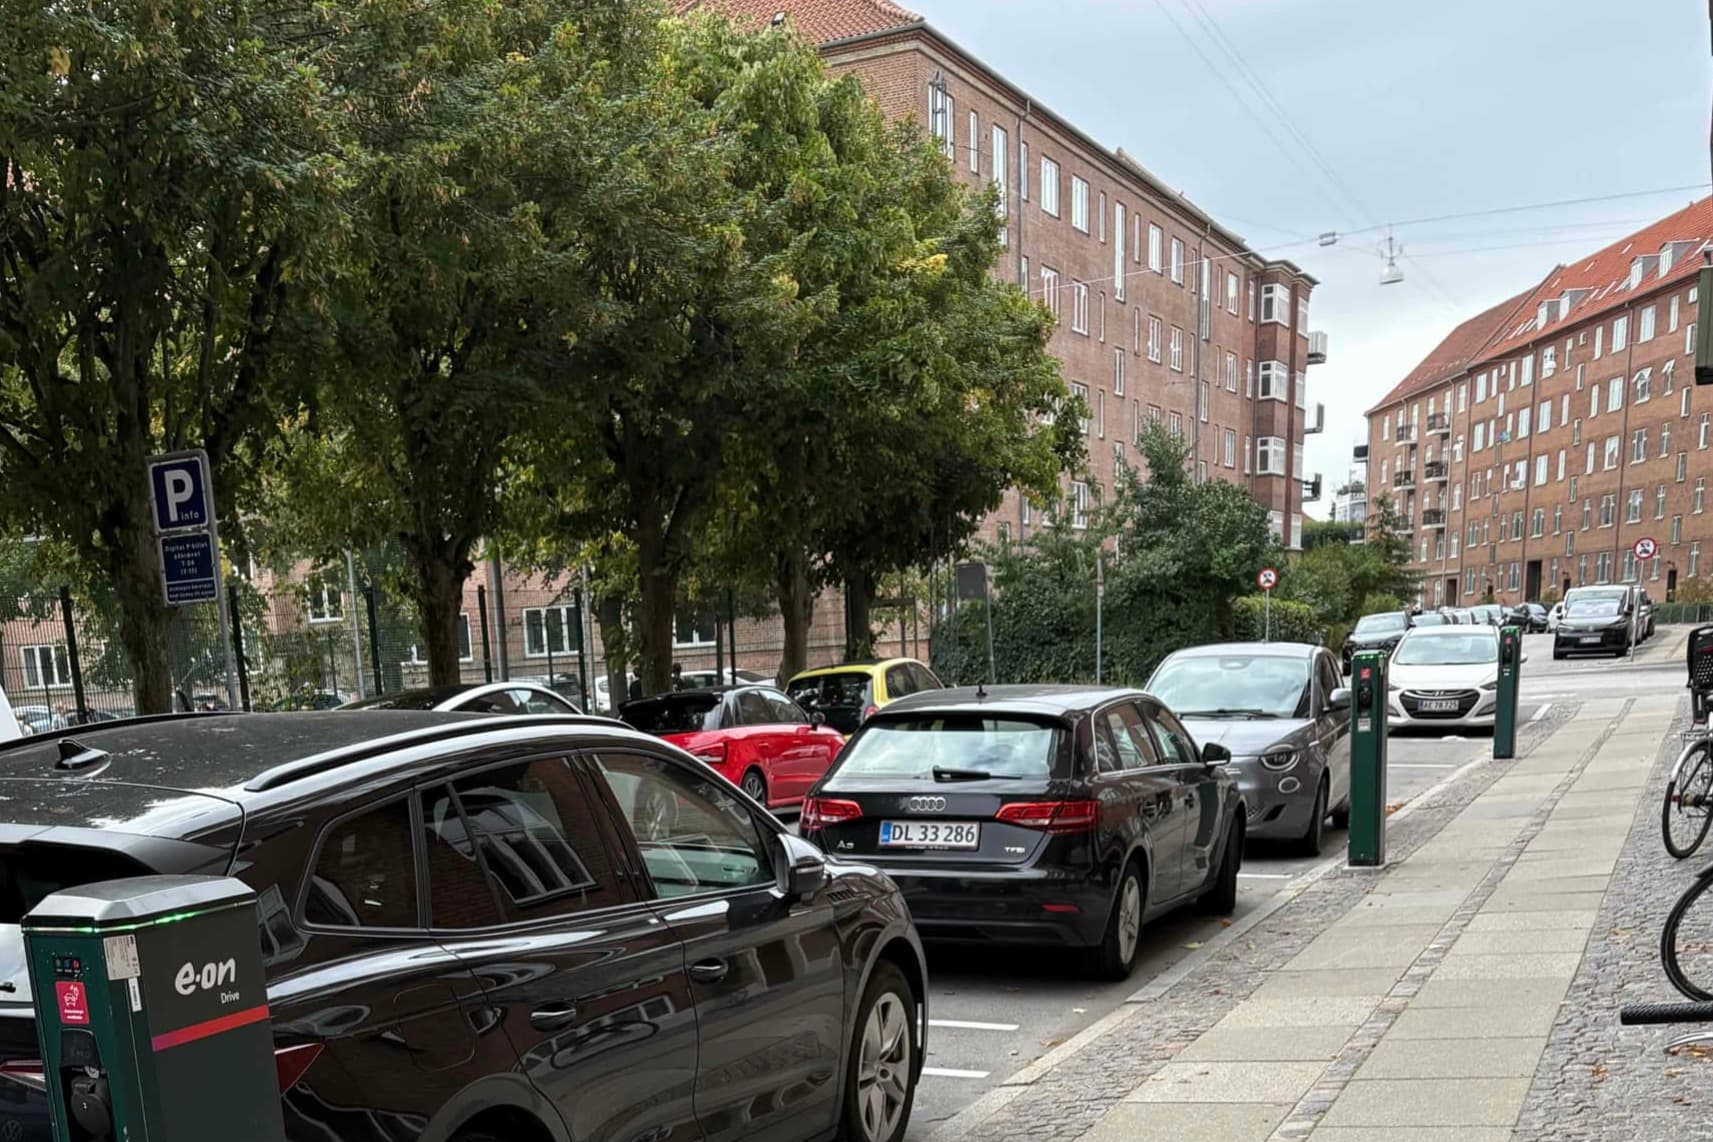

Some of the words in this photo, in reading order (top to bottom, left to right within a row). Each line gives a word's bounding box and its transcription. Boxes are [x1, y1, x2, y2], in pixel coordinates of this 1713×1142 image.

[164, 469, 194, 522] P
[892, 824, 913, 841] DL
[918, 825, 939, 842] 33
[943, 825, 975, 843] 286
[220, 990, 240, 1004] Drive
